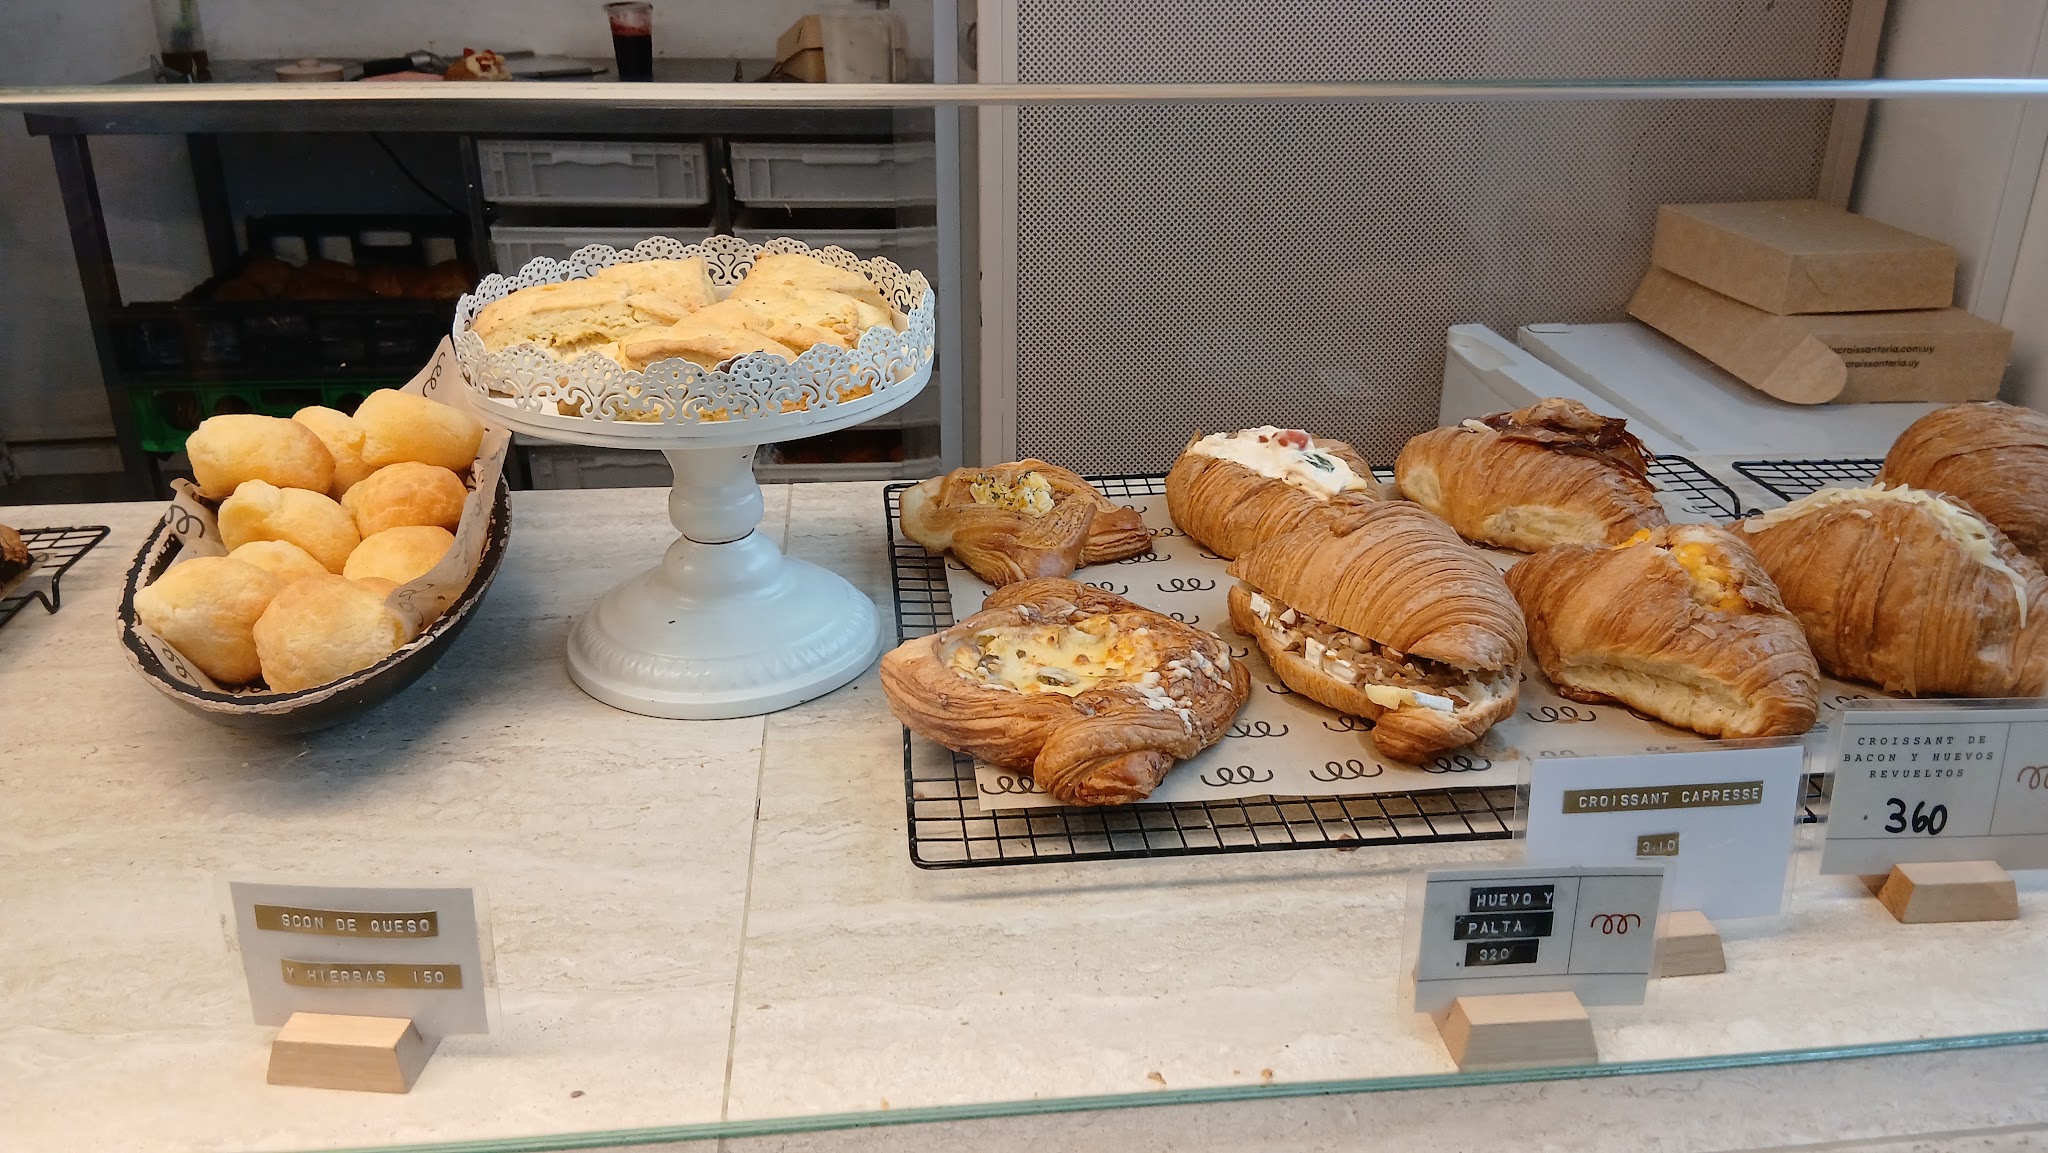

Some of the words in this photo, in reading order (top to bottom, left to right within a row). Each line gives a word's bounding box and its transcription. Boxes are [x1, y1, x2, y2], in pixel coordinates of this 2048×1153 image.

[1829, 345, 1935, 354] acroissanteria.com.uy
[1858, 736, 1955, 746] CROISSANT
[1968, 735, 1986, 744] DE
[1843, 753, 1896, 762] BACON
[1911, 753, 1918, 762] Y
[1933, 751, 1994, 761] HUEVOS
[1869, 769, 1964, 778] REVUELTOS
[1579, 792, 1669, 808] CROISSANT
[1681, 787, 1760, 803] CAPRESSE
[1885, 797, 1948, 835] 360
[1477, 893, 1532, 907] HUEVO
[1544, 892, 1553, 905] Y
[281, 913, 324, 929] SCON
[337, 918, 357, 932] DE
[371, 919, 431, 934] QUESO
[1468, 920, 1523, 934] PALTA
[1479, 948, 1510, 961] 320
[286, 967, 296, 979] Y
[307, 969, 386, 983] HIERBAS
[413, 971, 445, 983] 150
